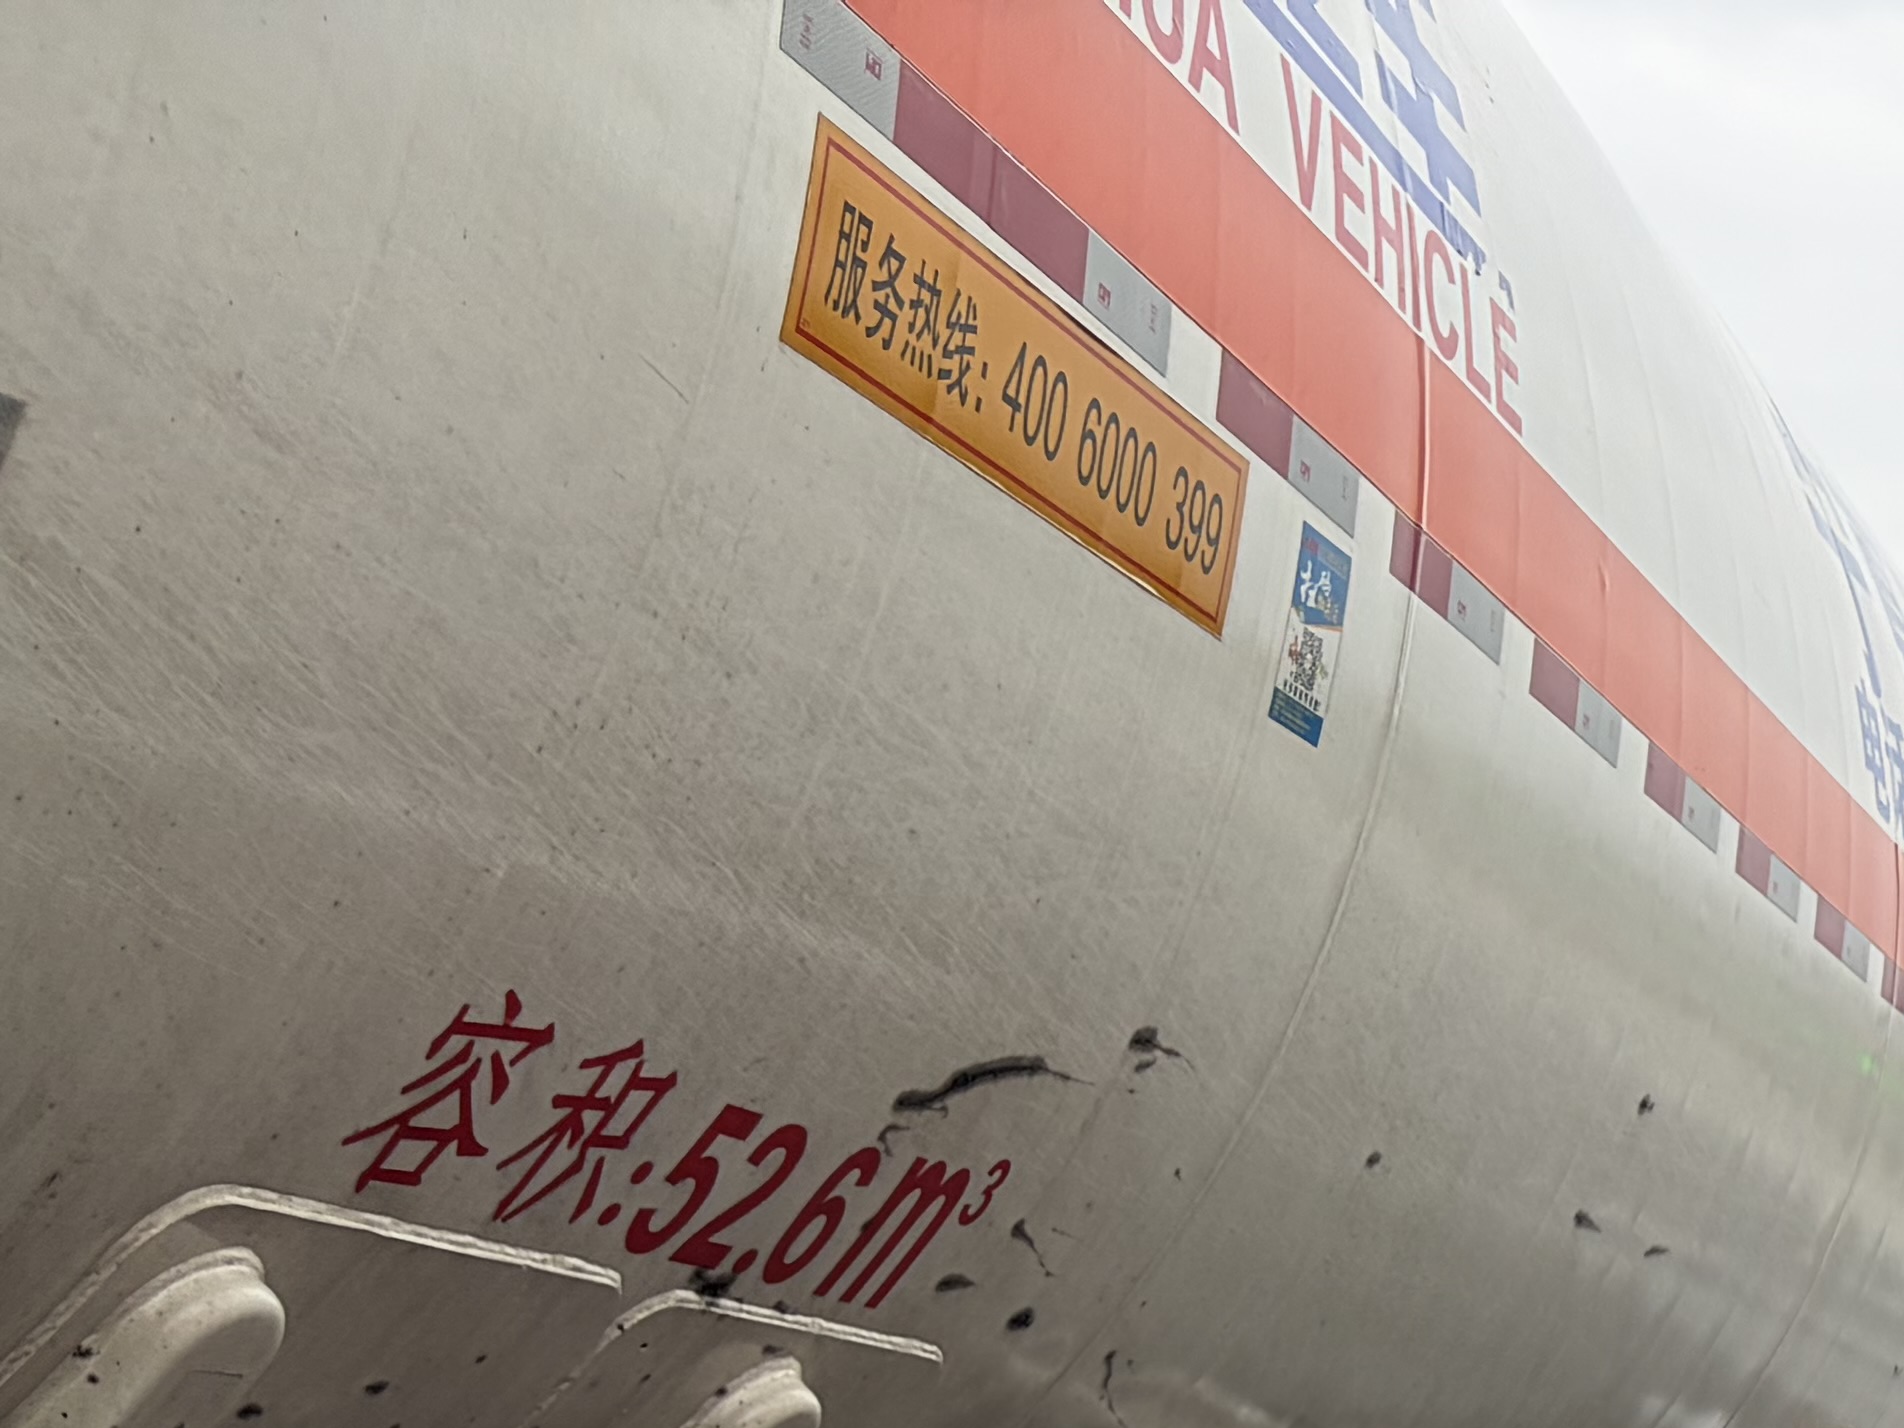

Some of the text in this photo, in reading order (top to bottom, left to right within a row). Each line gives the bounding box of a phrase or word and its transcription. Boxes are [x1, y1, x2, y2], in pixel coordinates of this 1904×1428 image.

[823, 199, 1224, 576] 服务热线: 400 6000 399
[1280, 52, 1523, 438] VEHICLE
